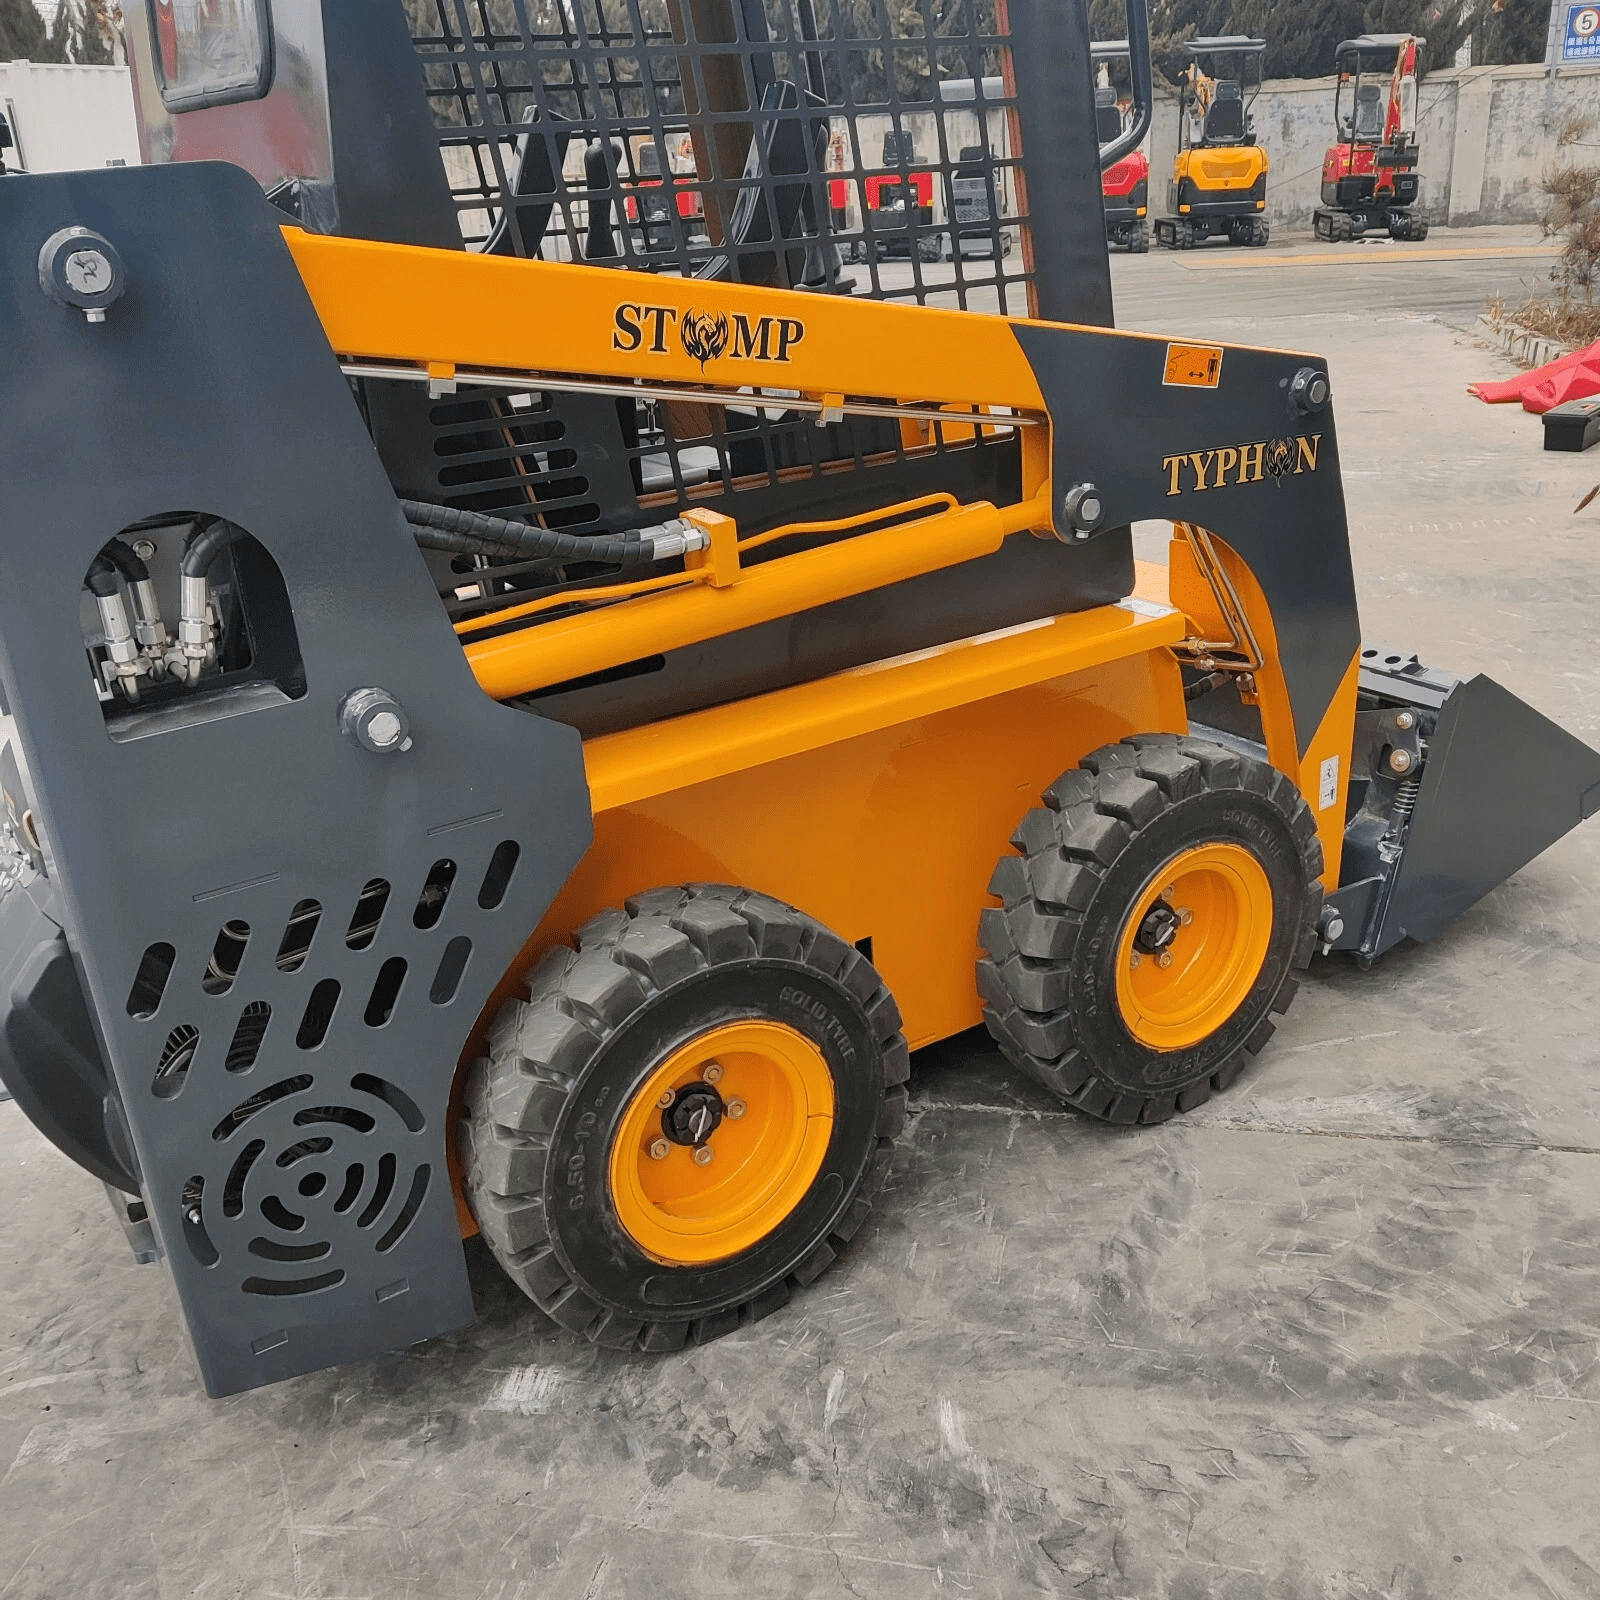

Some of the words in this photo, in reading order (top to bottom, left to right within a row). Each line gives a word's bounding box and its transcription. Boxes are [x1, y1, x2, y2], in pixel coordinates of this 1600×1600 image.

[1581, 13, 1593, 30] 5
[780, 985, 829, 1021] SOLID
[826, 1015, 857, 1062] TYRE
